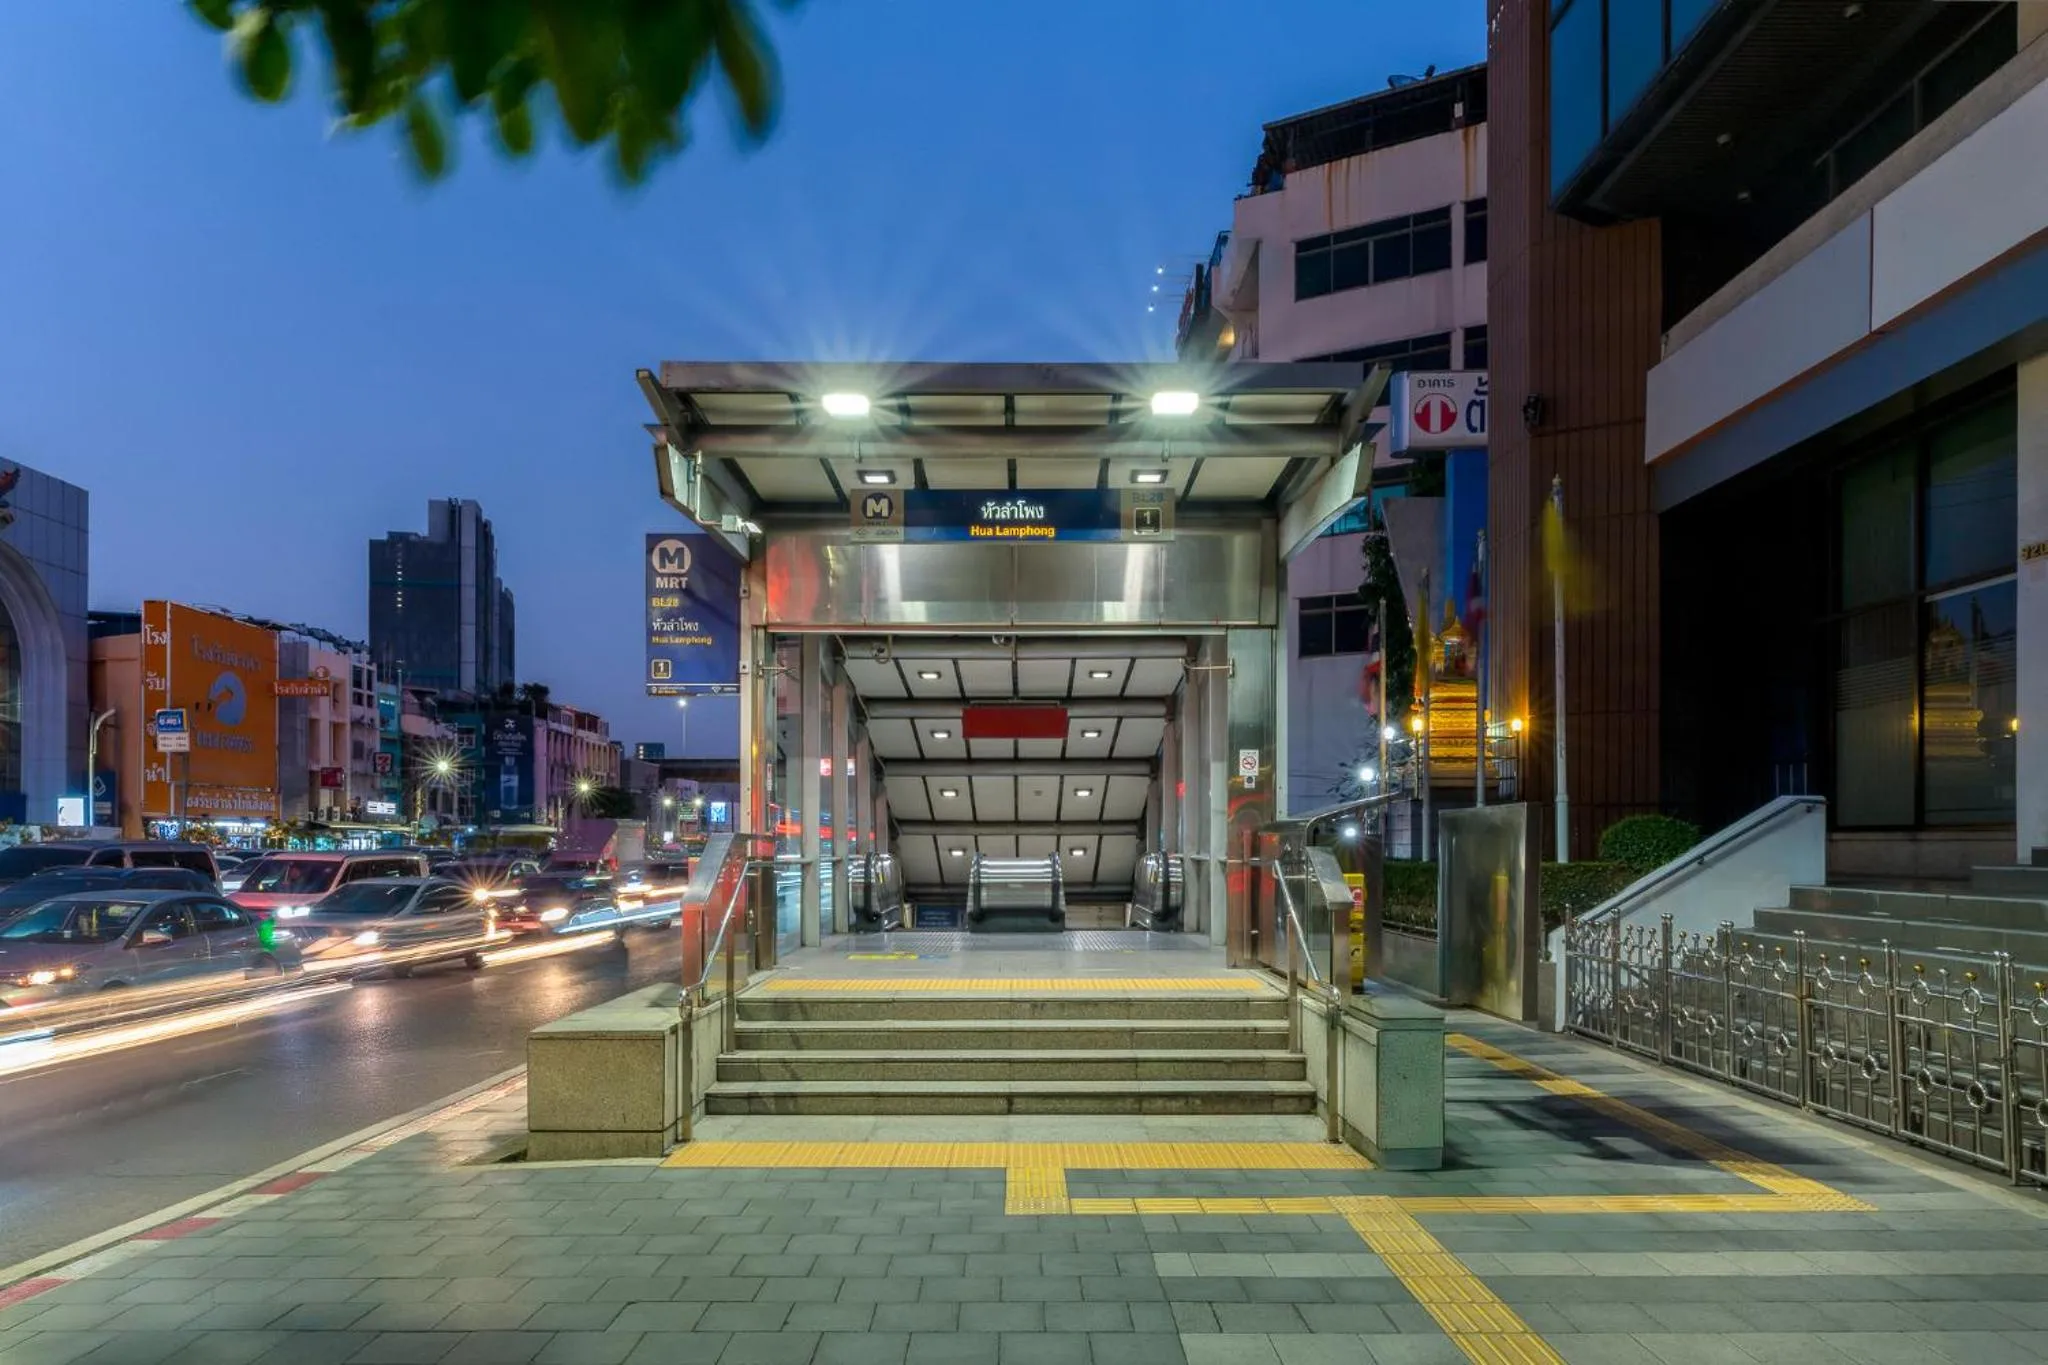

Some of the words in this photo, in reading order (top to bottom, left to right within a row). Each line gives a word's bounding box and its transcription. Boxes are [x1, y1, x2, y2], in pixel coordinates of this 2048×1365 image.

[1417, 378, 1455, 388] อาคาร
[866, 498, 889, 517] M
[981, 500, 1044, 519] หัวลำโพง
[1143, 510, 1151, 525] 1
[971, 525, 993, 536] Hua
[995, 525, 1056, 538] Lamphong
[658, 547, 685, 569] M
[656, 576, 689, 589] MRT
[652, 616, 699, 631] หัวลำโพง
[652, 636, 668, 644] Hua
[669, 636, 713, 645] Lamphong
